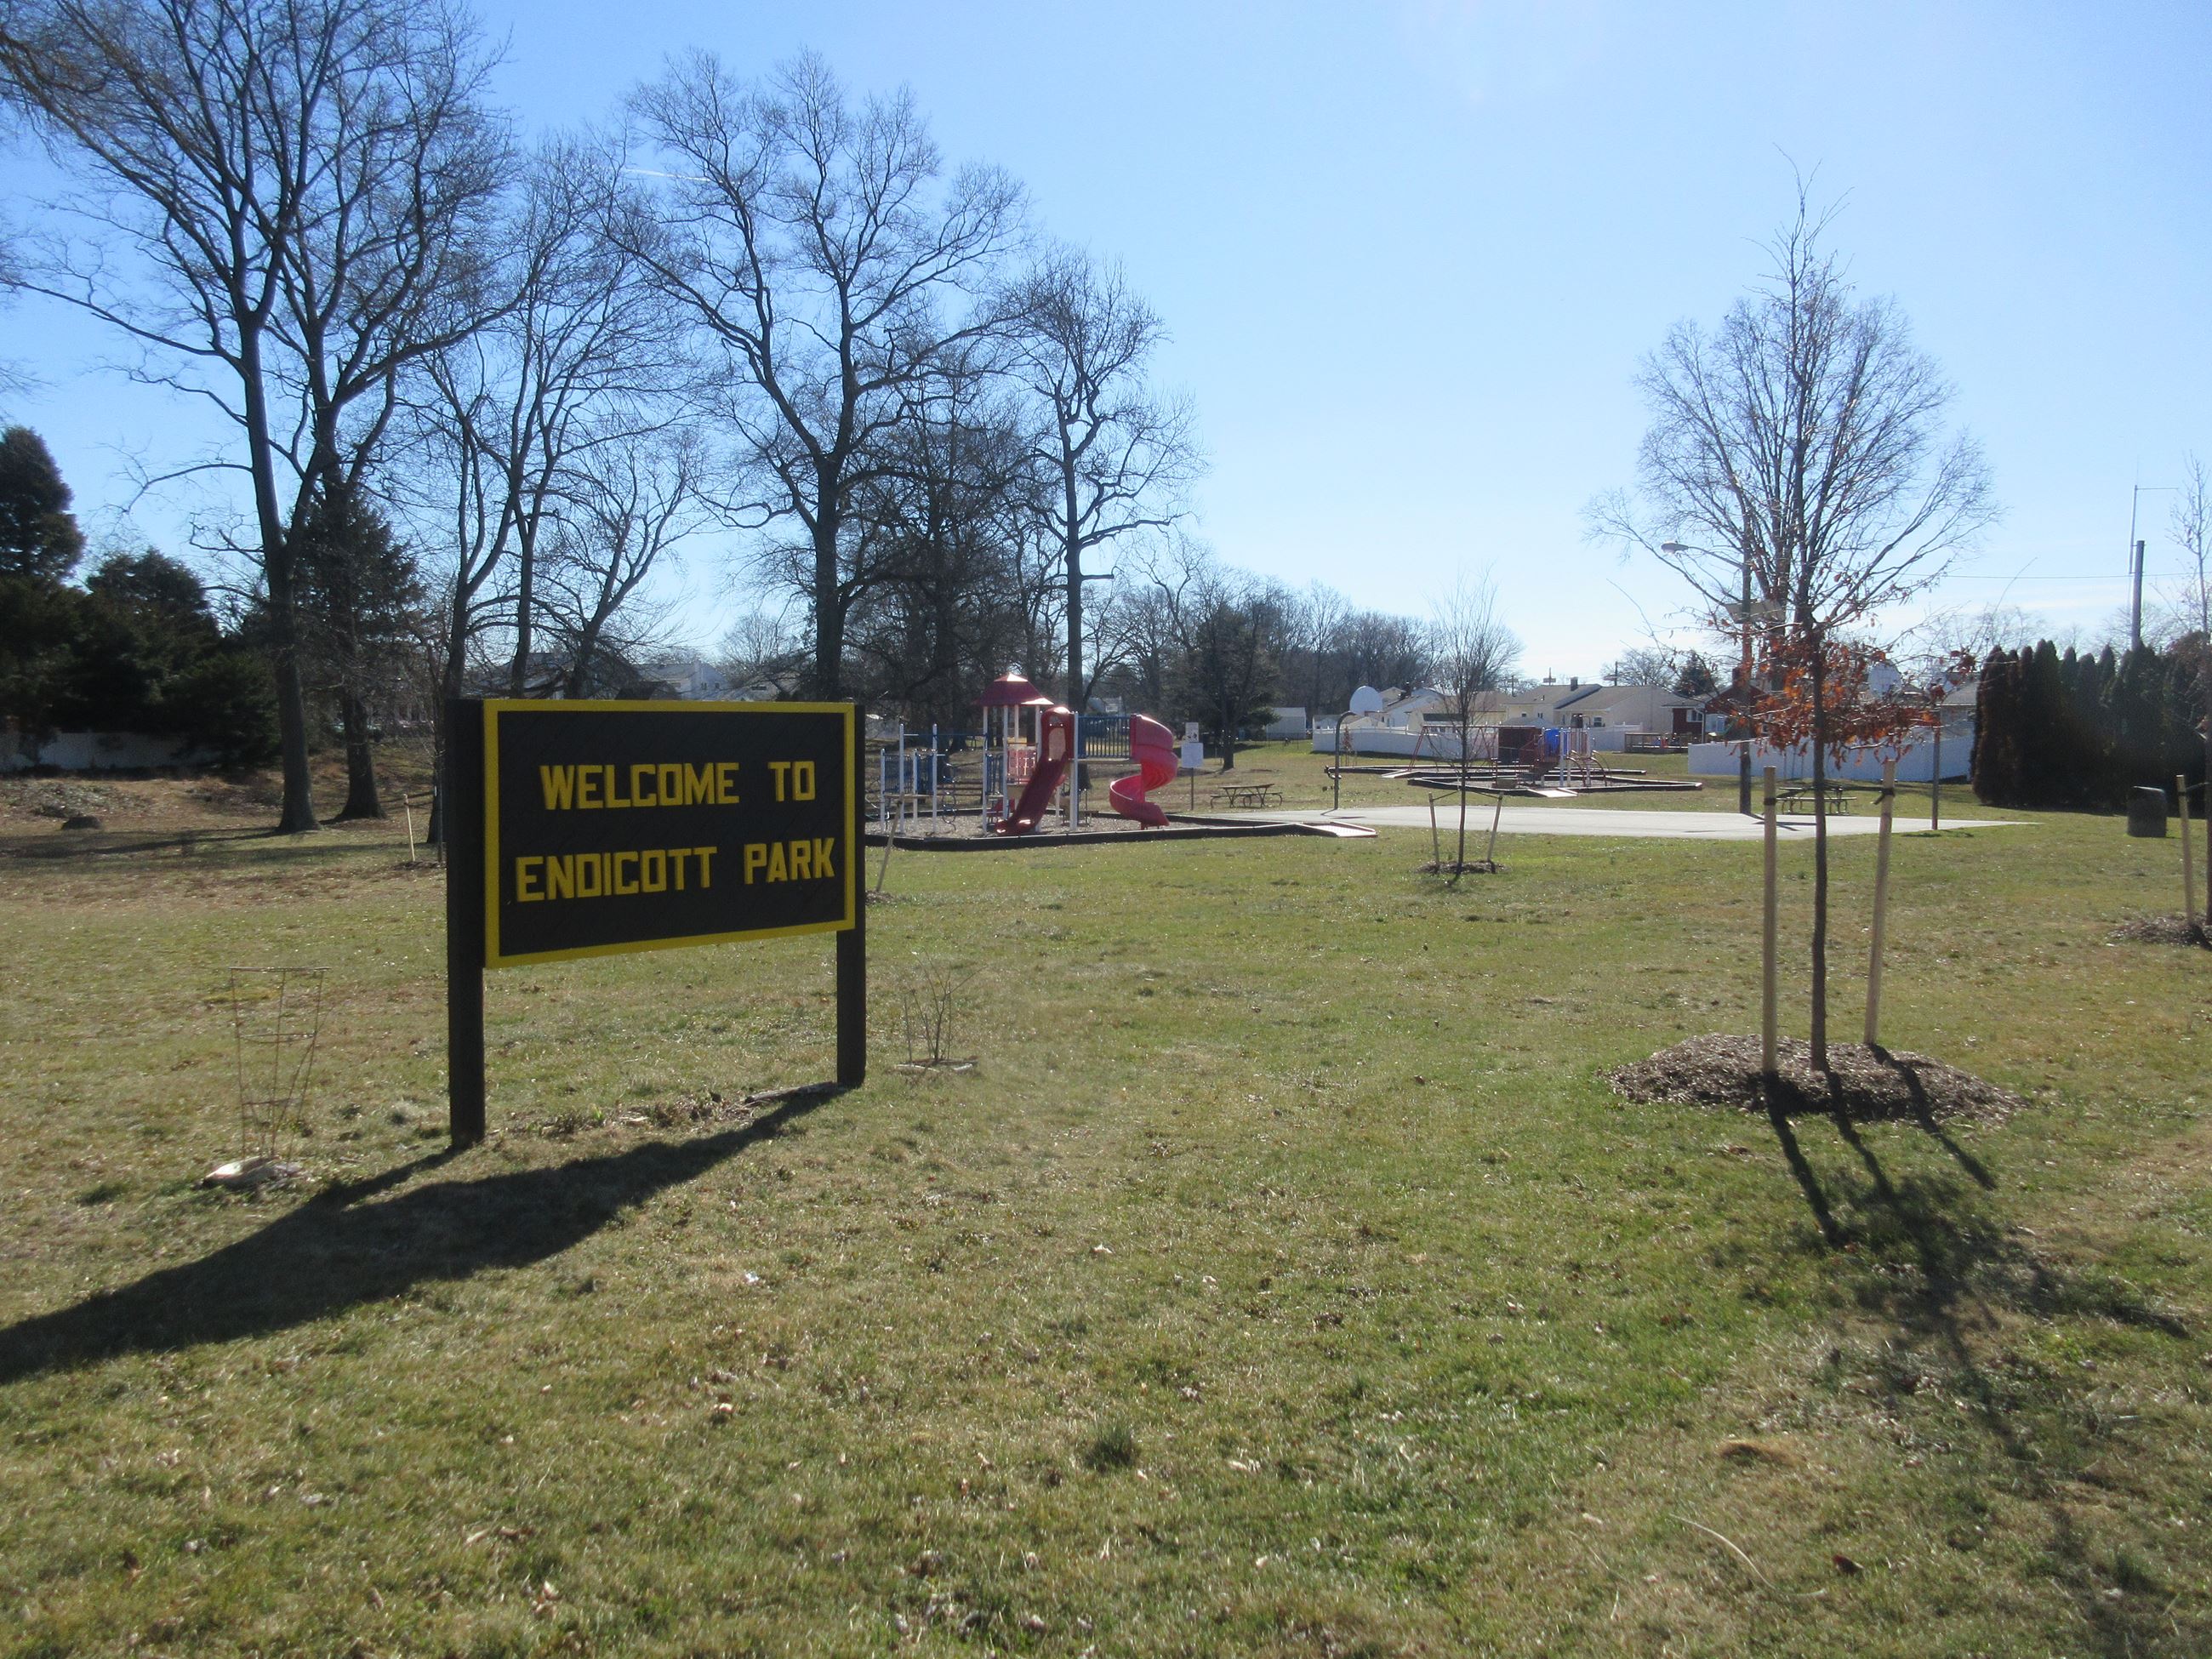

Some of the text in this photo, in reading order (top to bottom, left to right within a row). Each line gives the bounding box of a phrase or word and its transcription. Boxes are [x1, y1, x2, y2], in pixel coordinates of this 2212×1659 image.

[539, 761, 816, 810] WELCOME TO
[516, 838, 835, 902] ENDICOTT PARK
